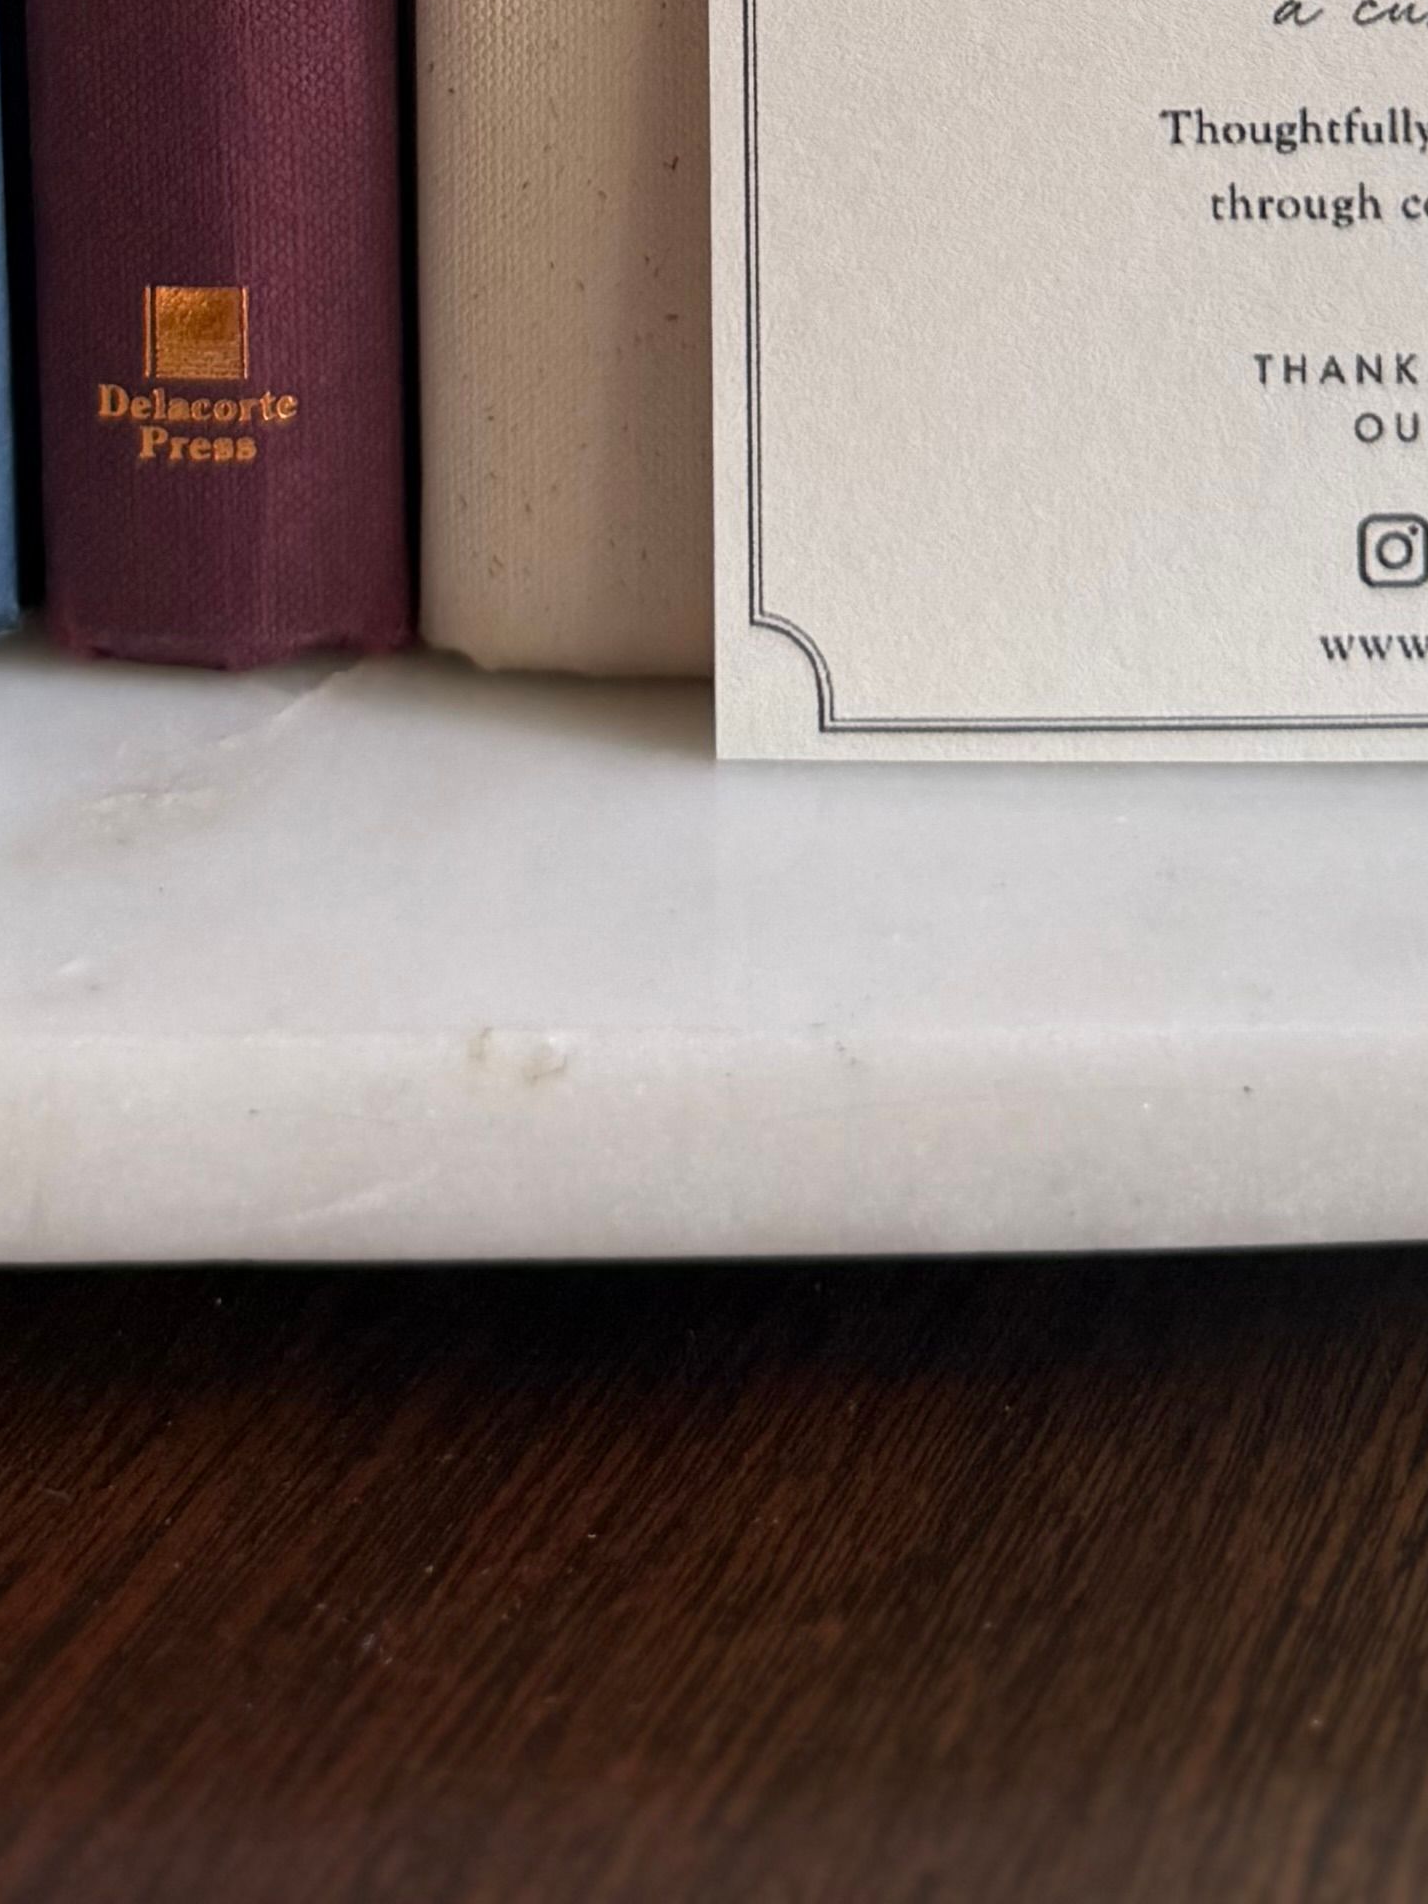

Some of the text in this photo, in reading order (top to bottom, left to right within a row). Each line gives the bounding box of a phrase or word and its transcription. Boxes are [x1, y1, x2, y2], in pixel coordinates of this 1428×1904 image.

[1210, 182, 1382, 229] through
[1254, 352, 1420, 387] THANK
[98, 384, 300, 422] Delacorte
[139, 425, 258, 461] Press
